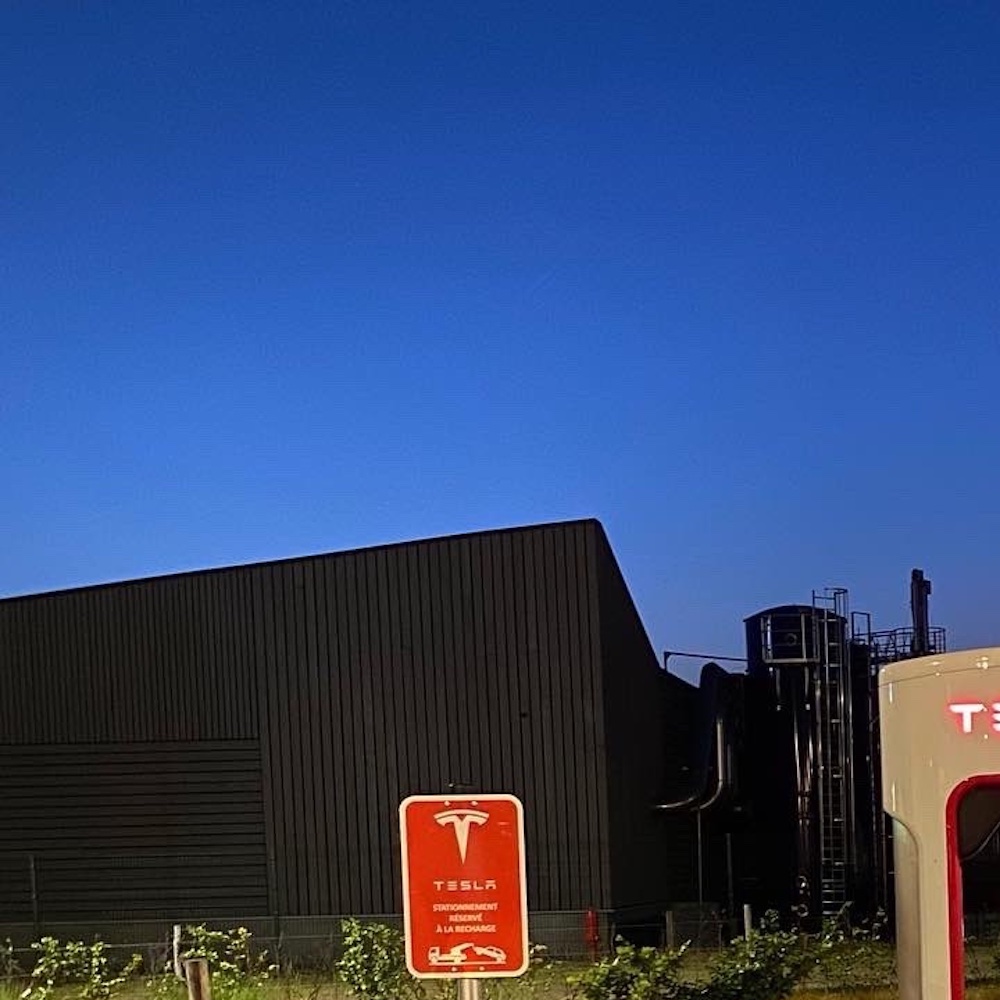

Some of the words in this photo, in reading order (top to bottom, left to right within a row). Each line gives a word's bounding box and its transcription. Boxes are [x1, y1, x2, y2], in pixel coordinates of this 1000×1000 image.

[433, 879, 497, 891] TESLA
[432, 902, 498, 912] STATIONNEMENT
[443, 925, 454, 933] LA
[454, 924, 497, 933] RECHARGE
